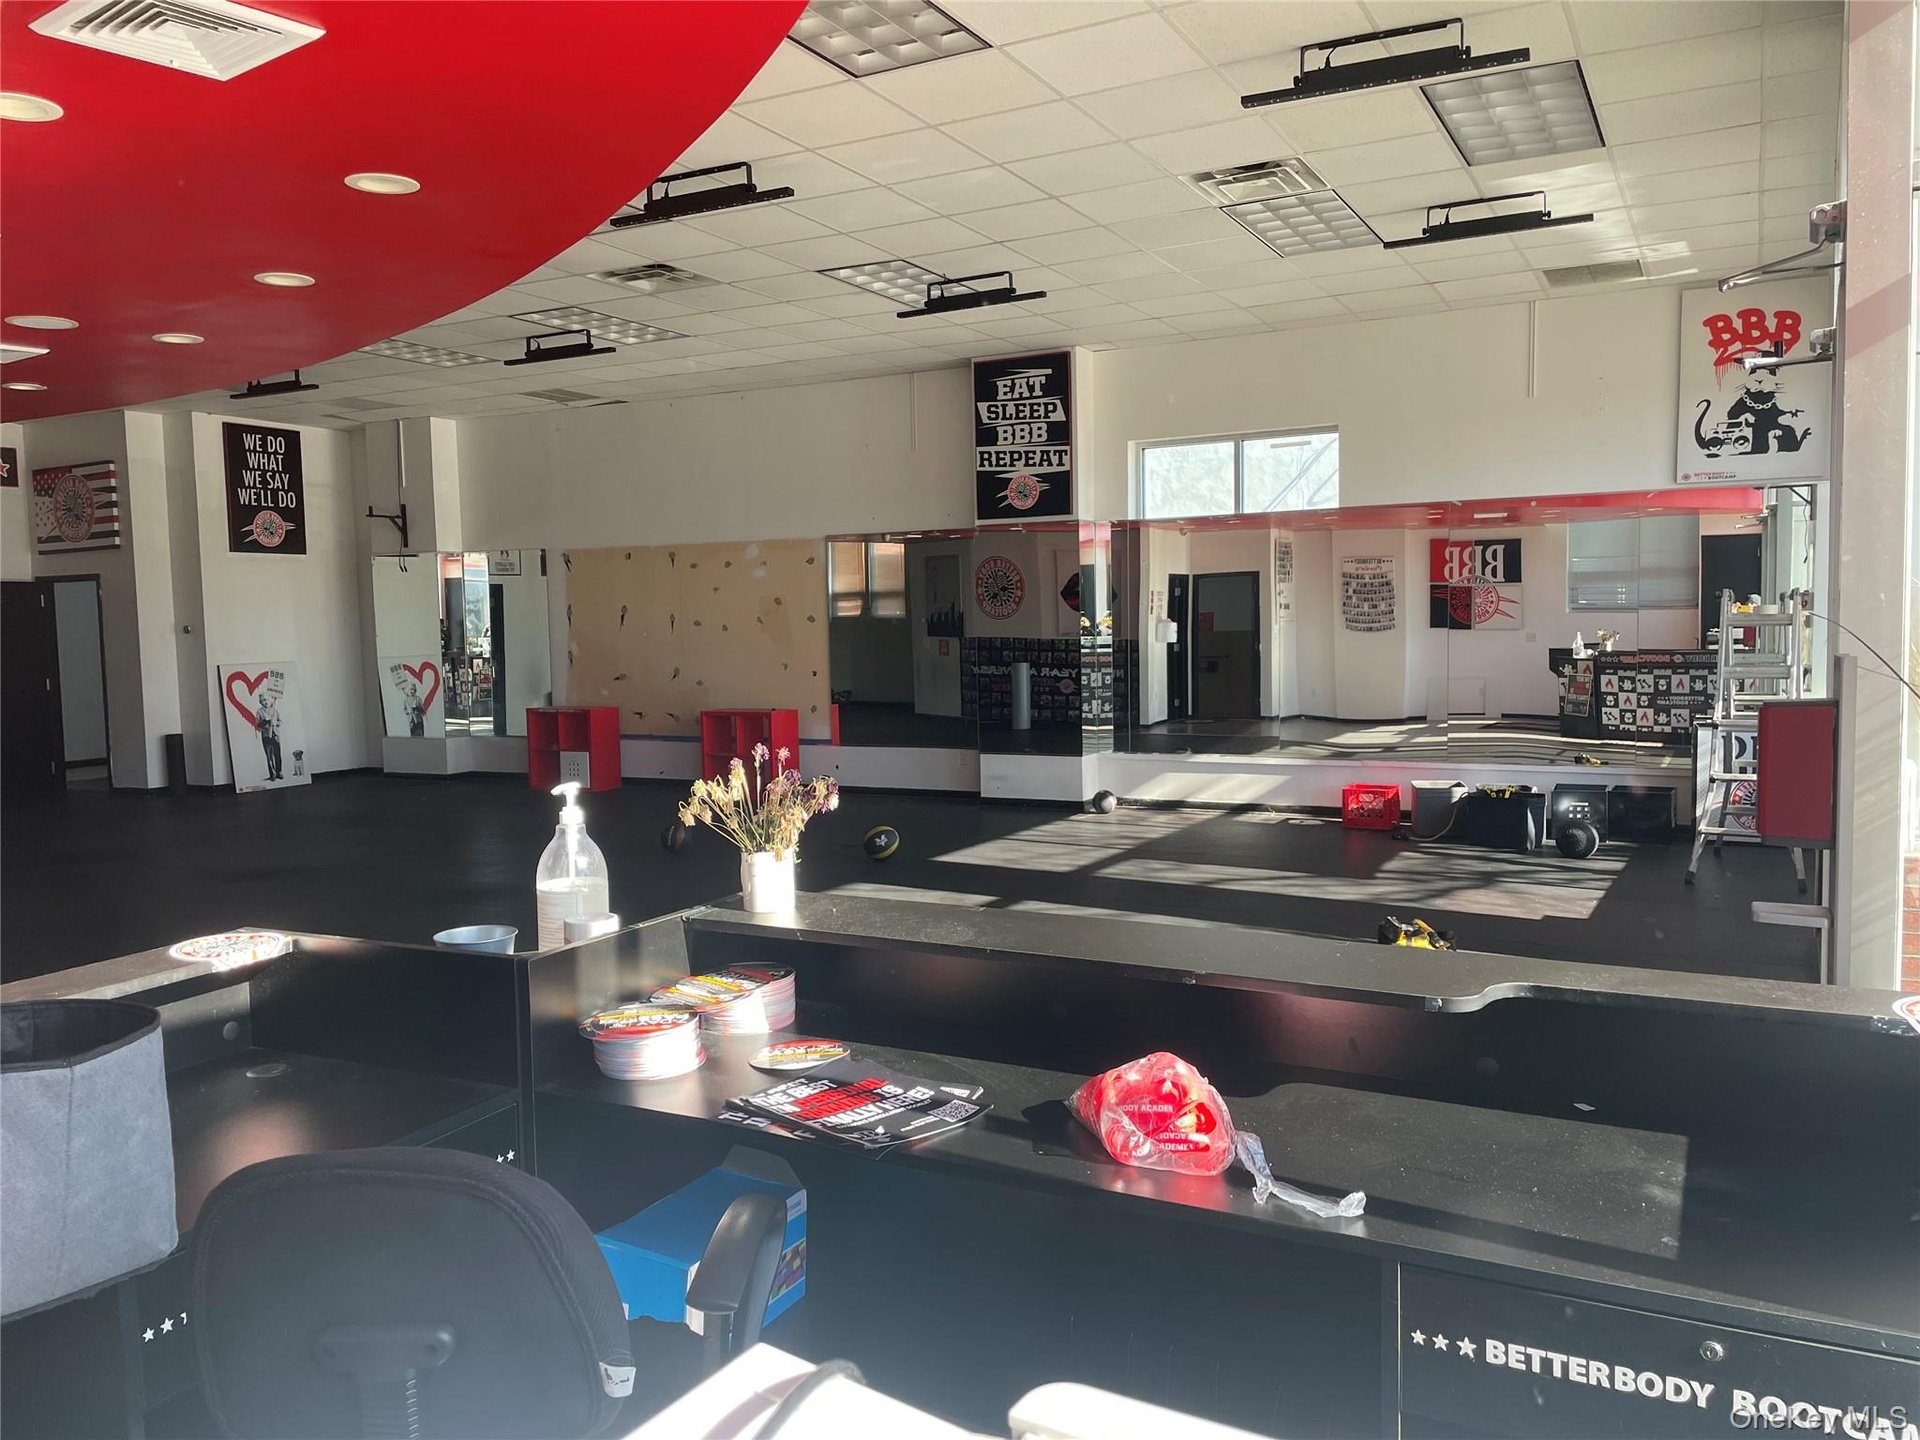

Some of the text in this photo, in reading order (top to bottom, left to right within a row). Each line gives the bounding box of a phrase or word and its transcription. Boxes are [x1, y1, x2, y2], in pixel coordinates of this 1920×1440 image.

[1702, 308, 1801, 351] BBB
[996, 375, 1046, 400] EAT
[986, 401, 1058, 421] SLEEP
[242, 433, 285, 454] WE DO
[996, 422, 1048, 446] BBB
[246, 451, 284, 471] WHAT
[978, 449, 1068, 468] REPEAT
[242, 469, 290, 490] WE SAY
[237, 487, 297, 508] WE'LL DO
[750, 1092, 795, 1107] THE
[786, 1079, 838, 1099] BEST
[792, 1075, 890, 1110] PERSONAL
[873, 1084, 905, 1098] IS
[805, 1103, 884, 1128] FINALLY
[875, 1085, 935, 1110] HERE!
[1119, 1104, 1139, 1112] ODY
